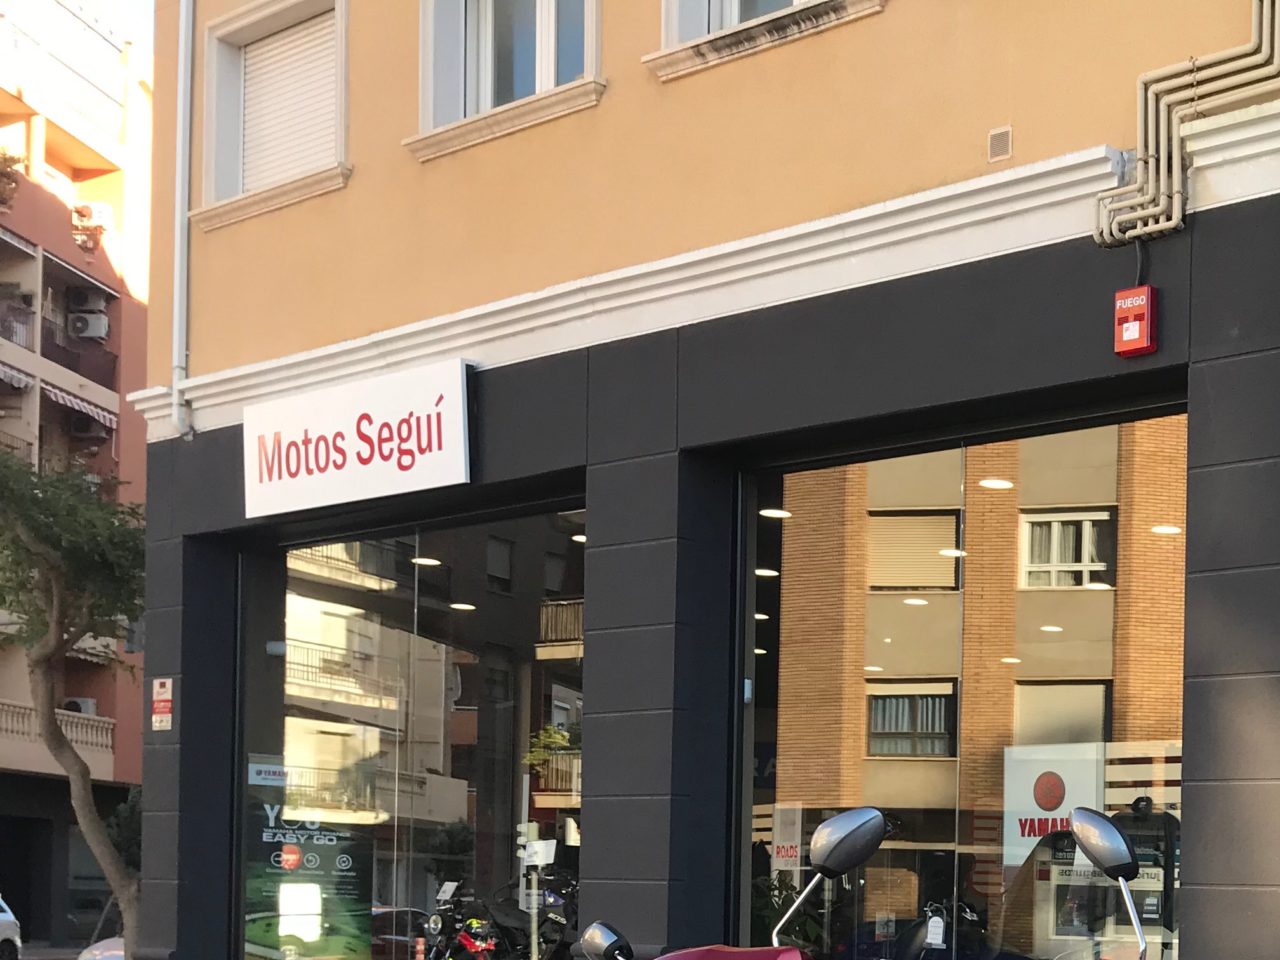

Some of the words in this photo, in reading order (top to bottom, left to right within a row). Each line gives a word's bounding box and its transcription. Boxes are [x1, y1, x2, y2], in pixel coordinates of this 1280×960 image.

[1116, 295, 1146, 309] FUEGO
[258, 429, 347, 483] Motos
[356, 393, 444, 472] Seguí
[1018, 817, 1071, 837] YAMAH
[263, 833, 308, 843] EASY
[313, 835, 337, 845] GO
[776, 845, 798, 859] ROADS
